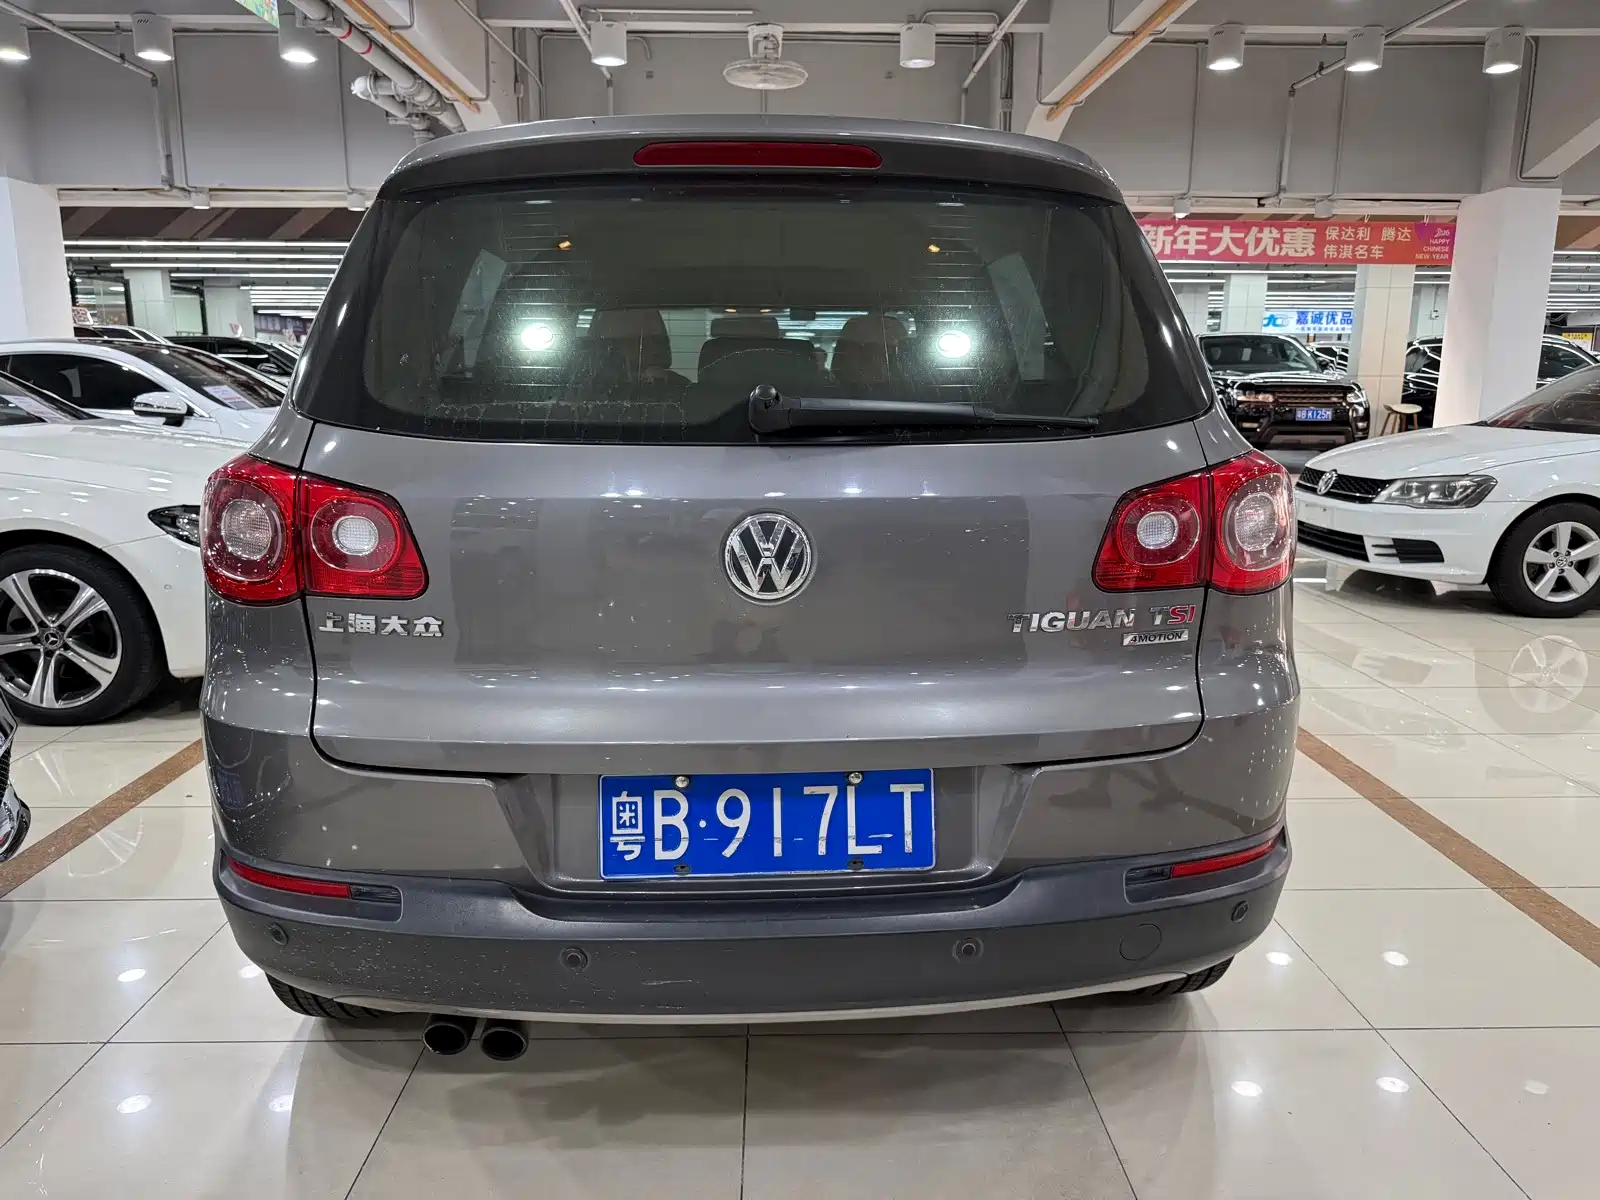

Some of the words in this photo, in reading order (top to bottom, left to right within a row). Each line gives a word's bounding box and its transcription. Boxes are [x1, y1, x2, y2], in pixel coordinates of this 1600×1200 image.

[1141, 224, 1317, 257] 新年大优惠
[1325, 226, 1371, 241] 保达利
[1381, 227, 1411, 242] 腾达
[1323, 244, 1385, 259] 伟淇名车
[318, 611, 444, 637] 上海大众
[1007, 608, 1136, 633] TIGUAN
[1150, 604, 1197, 626] TSI
[1129, 632, 1184, 643] 4MOTION
